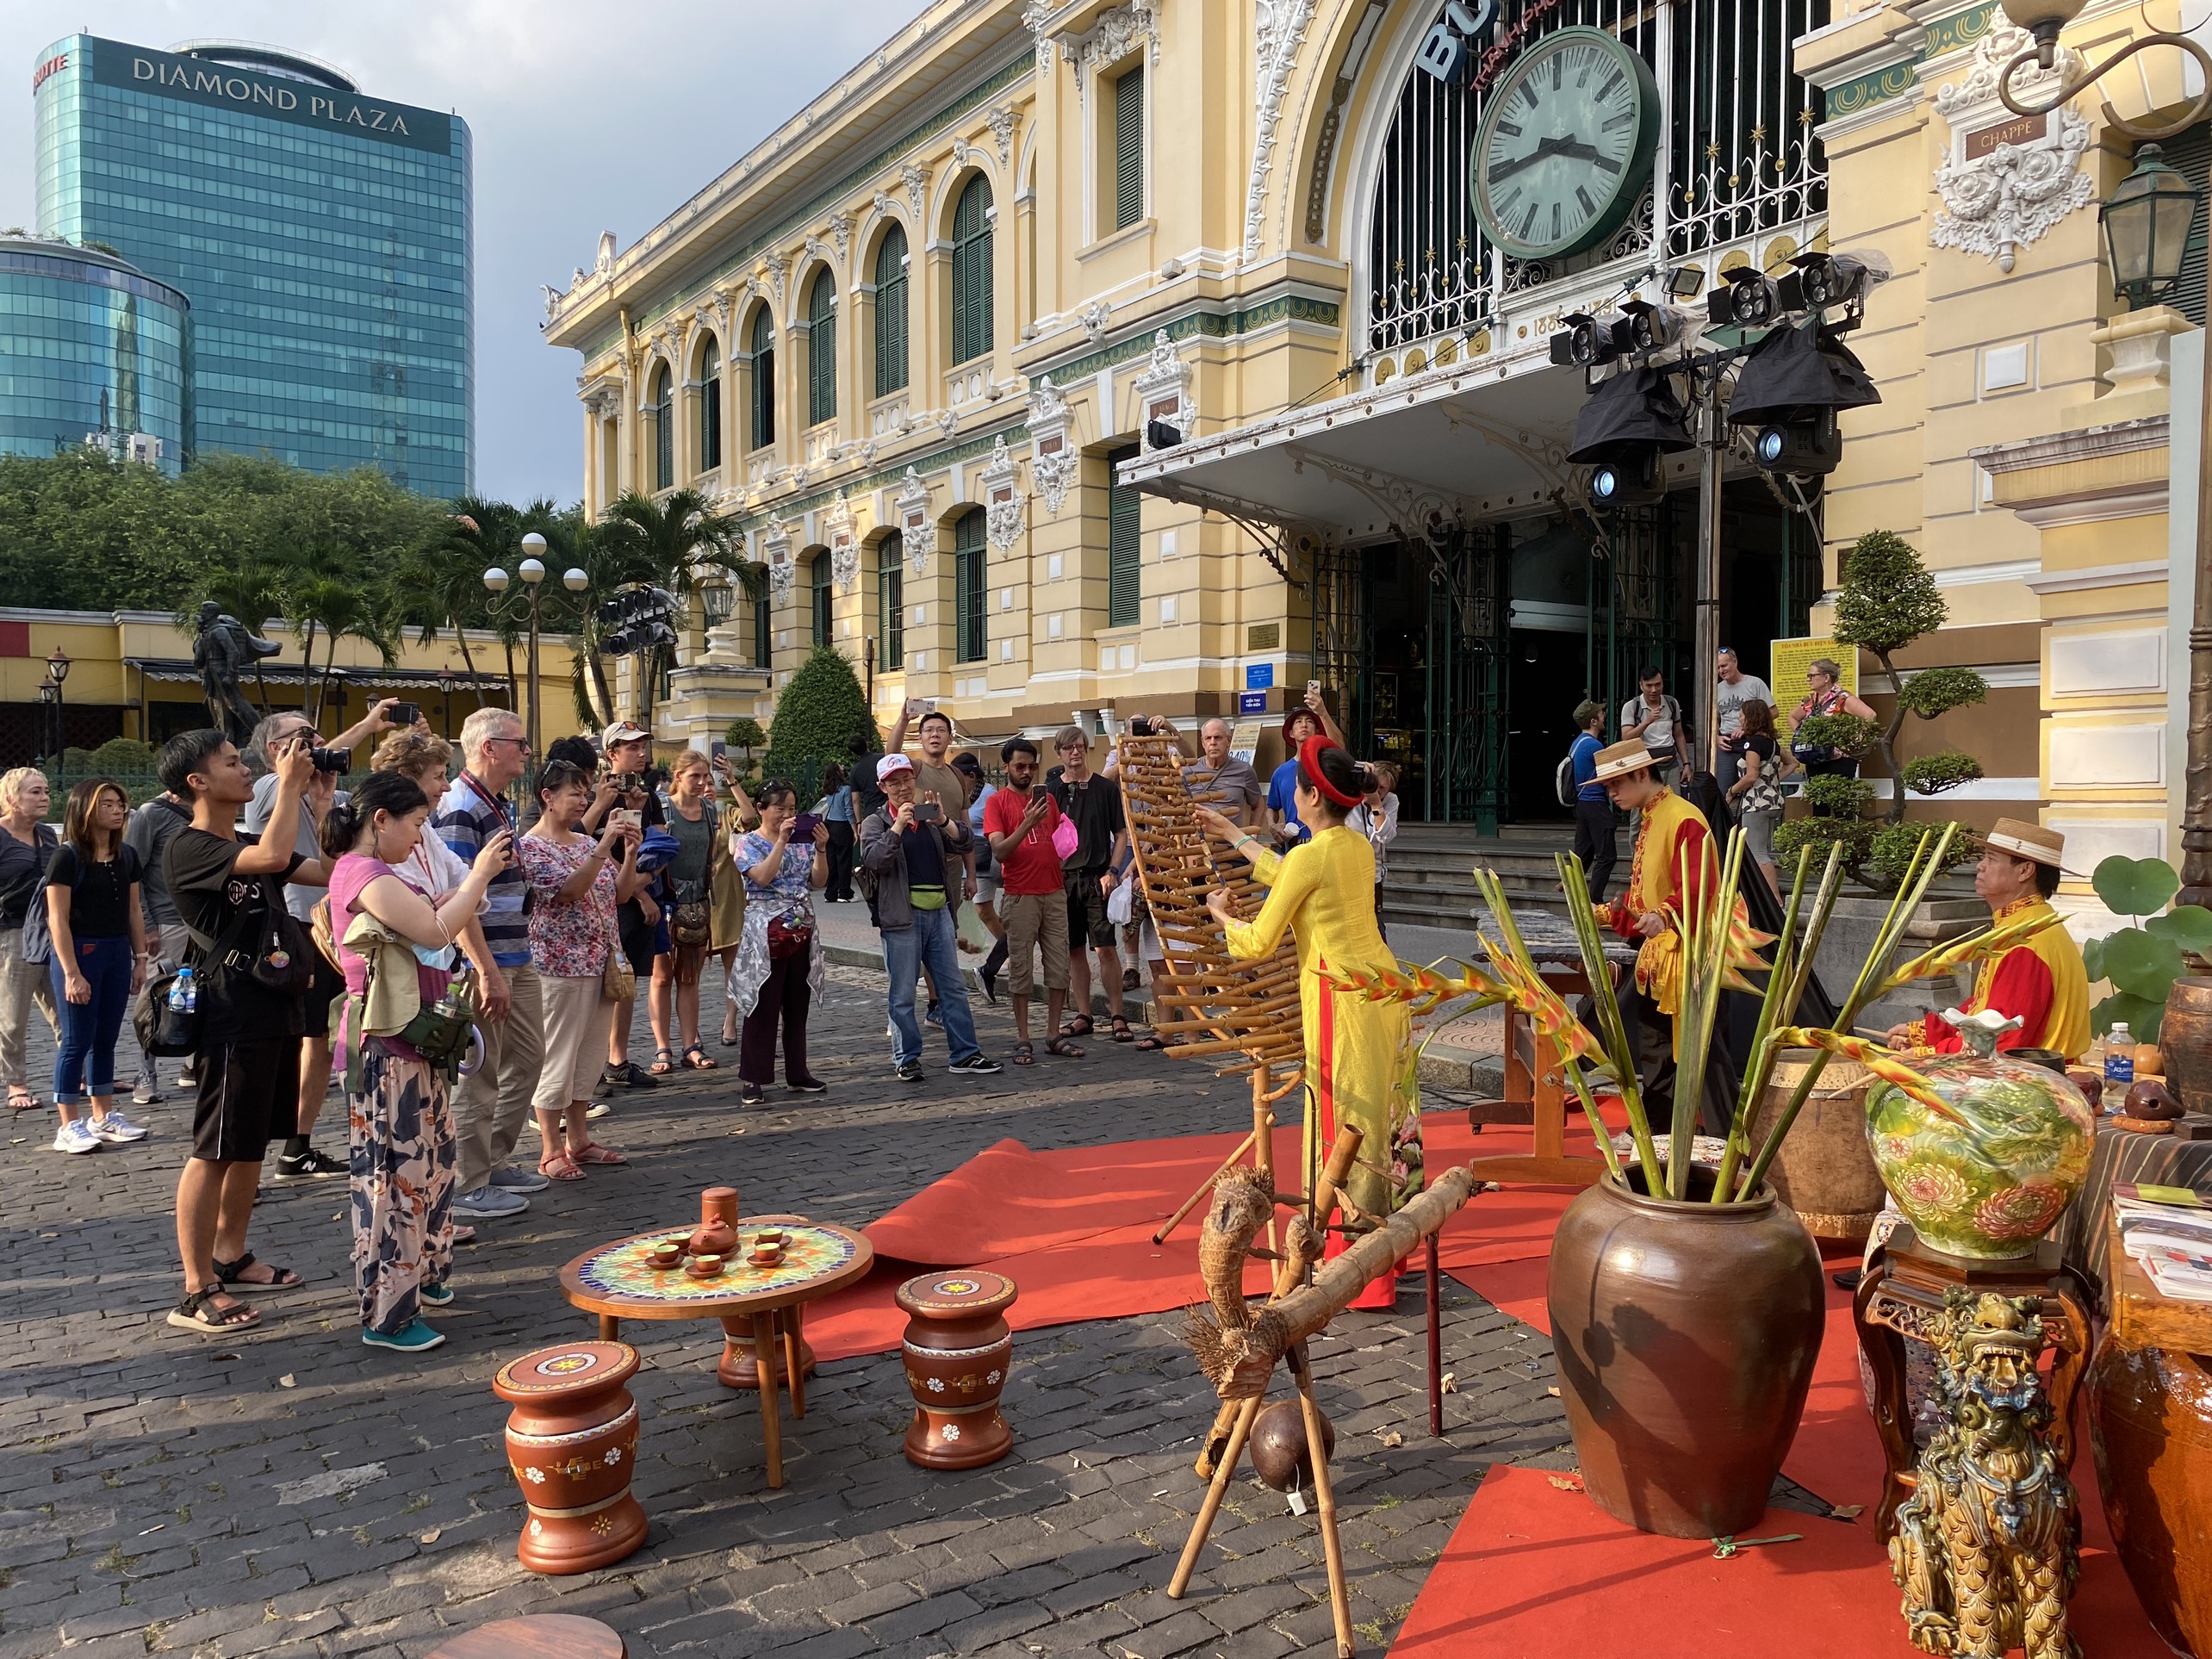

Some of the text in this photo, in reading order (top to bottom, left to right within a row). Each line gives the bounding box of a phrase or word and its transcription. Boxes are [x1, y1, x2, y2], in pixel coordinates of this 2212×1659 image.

[134, 58, 410, 136] DIAMOND PLAZA
[1981, 121, 2033, 147] CHAPPE
